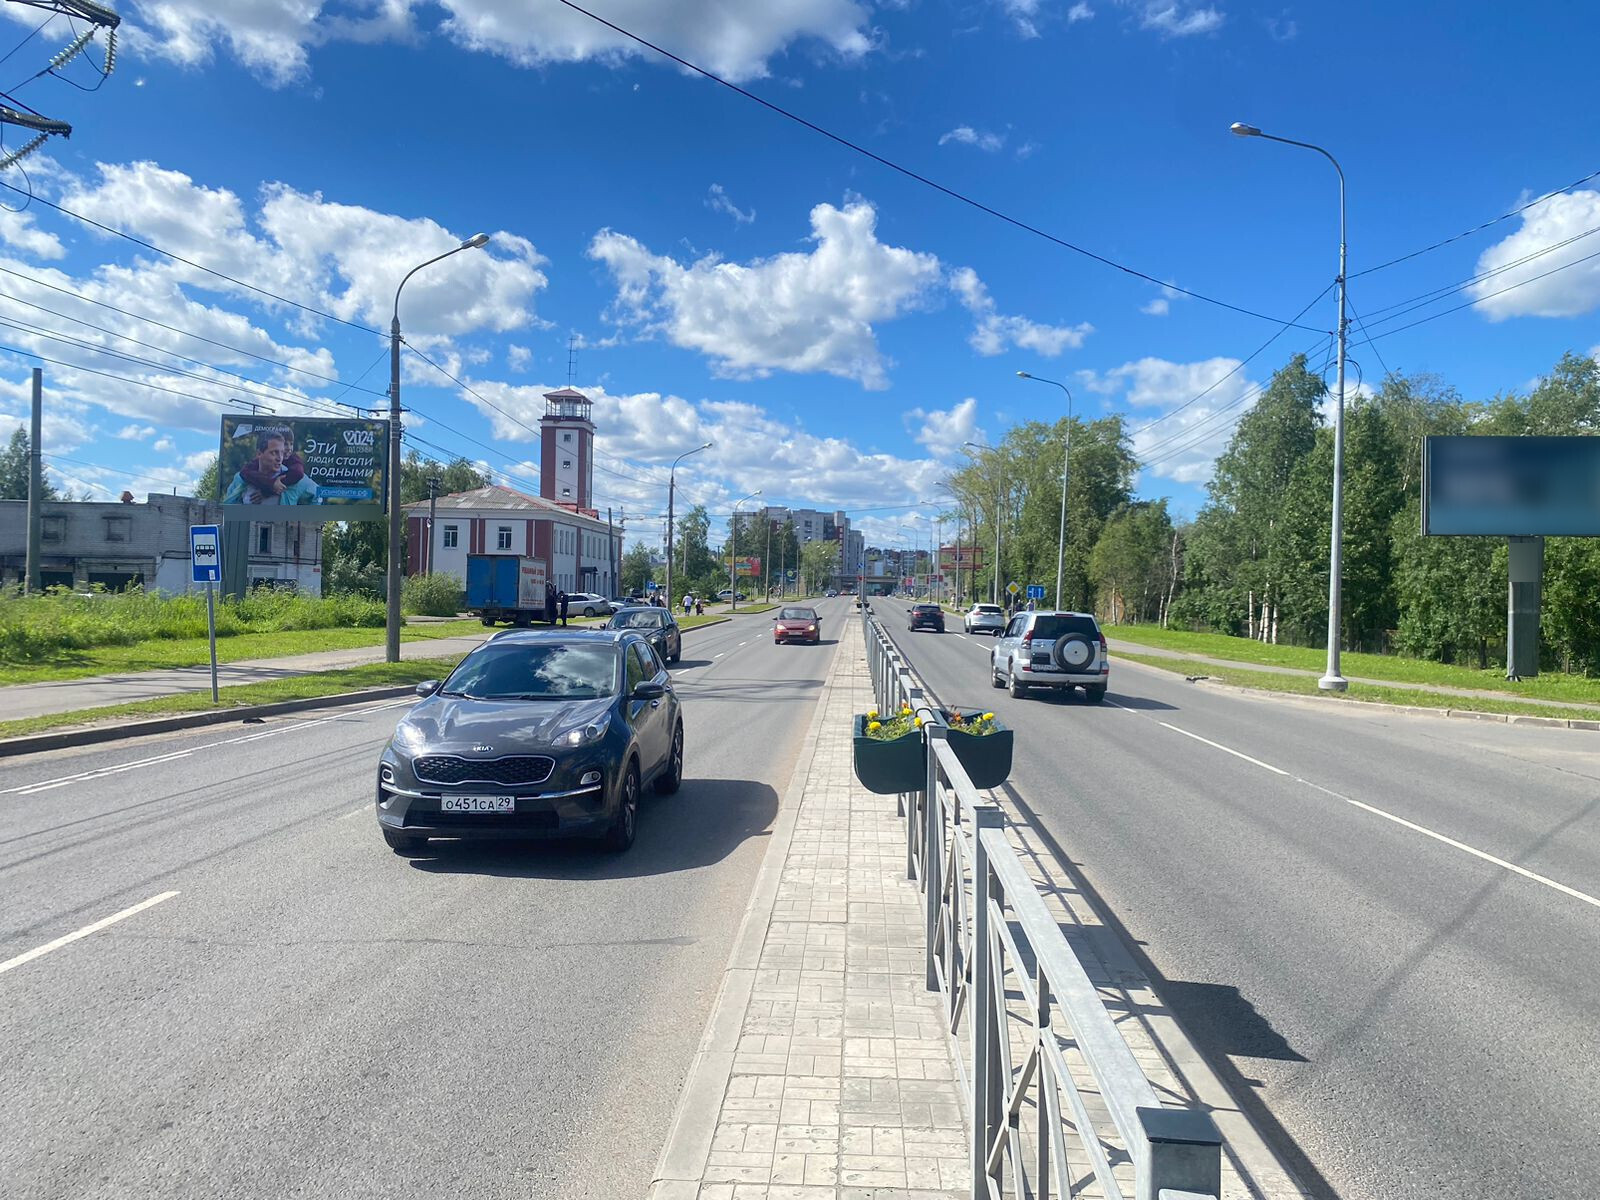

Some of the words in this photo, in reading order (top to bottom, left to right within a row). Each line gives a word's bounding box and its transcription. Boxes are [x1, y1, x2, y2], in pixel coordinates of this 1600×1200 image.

[343, 430, 375, 446] 2024
[303, 439, 337, 455] Эти
[306, 456, 334, 464] люди
[336, 457, 374, 466] стали
[310, 467, 374, 478] родными
